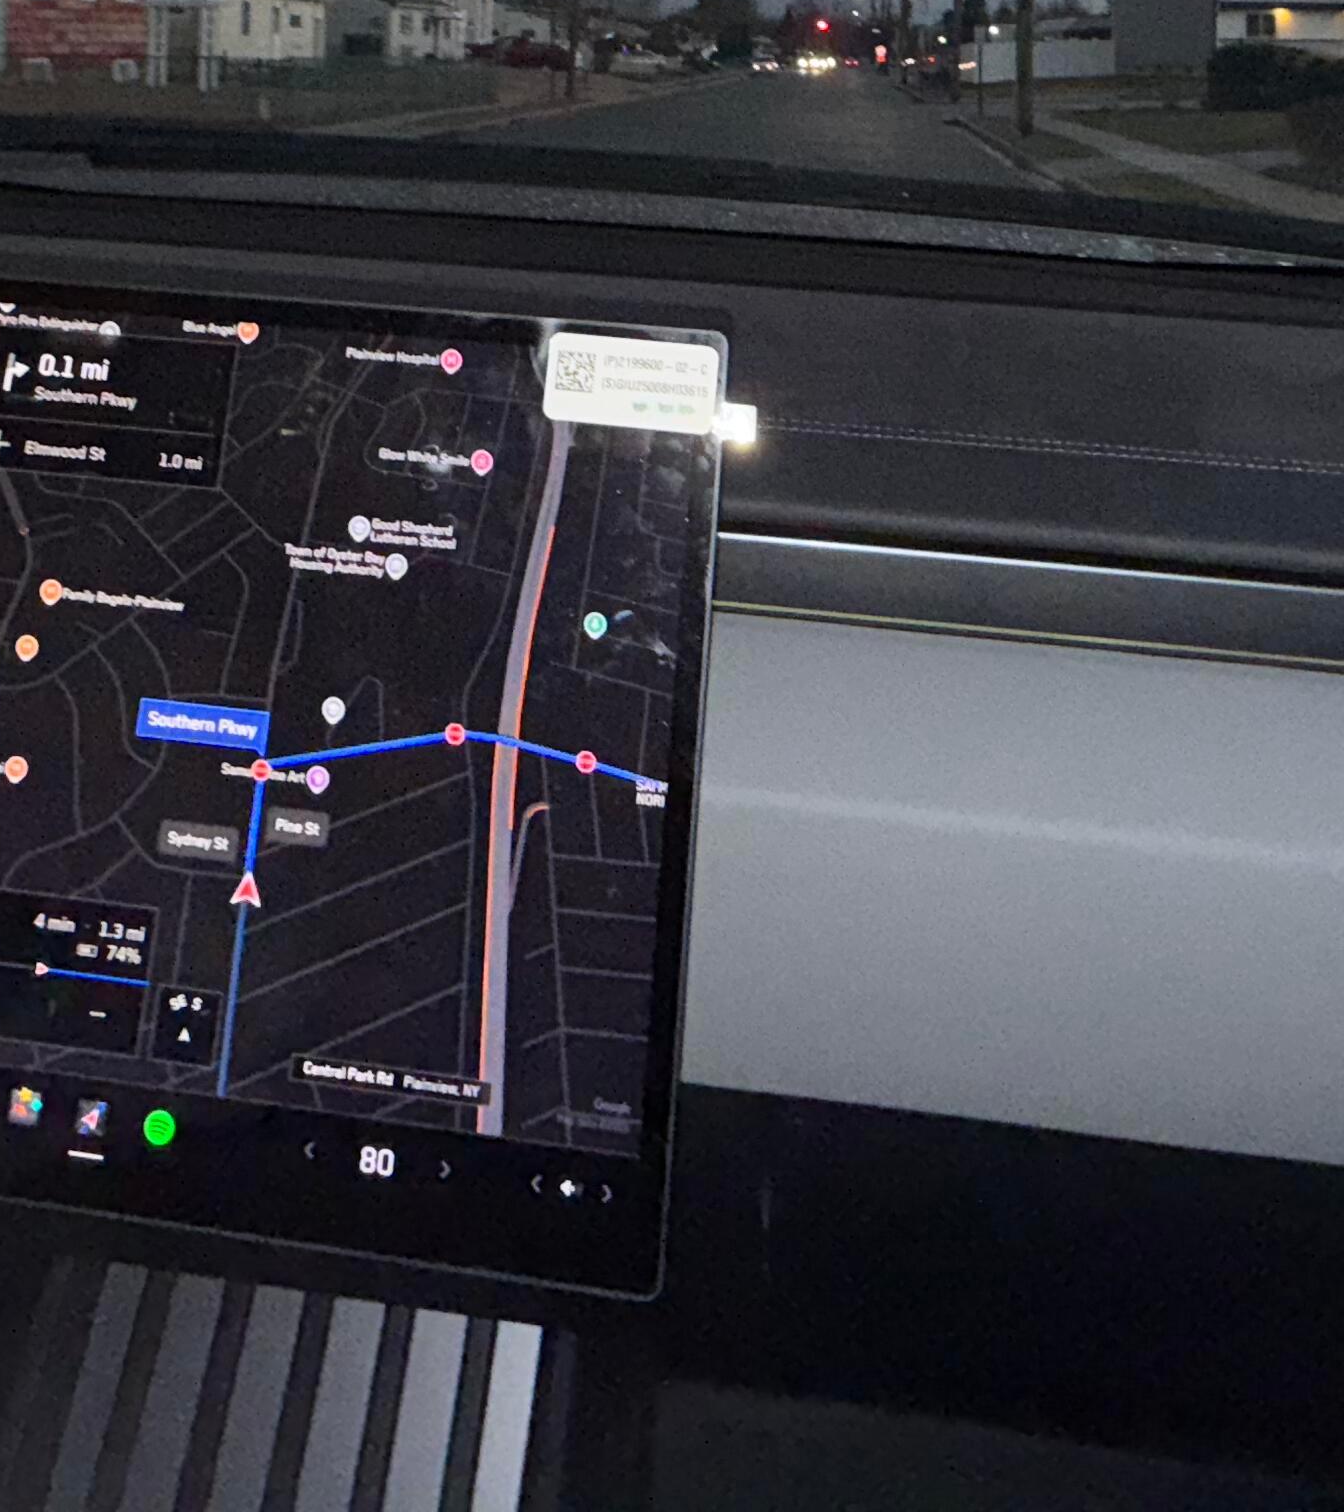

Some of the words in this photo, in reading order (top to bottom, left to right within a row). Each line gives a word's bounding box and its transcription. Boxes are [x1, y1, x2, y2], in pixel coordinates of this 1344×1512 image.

[38, 352, 74, 379] 0.1
[80, 357, 111, 381] mi
[34, 385, 98, 406] Southern
[99, 391, 138, 412] Pkwy
[23, 439, 88, 460] Elmwood
[88, 445, 106, 462] St
[158, 452, 183, 470] 1.0
[184, 455, 204, 471] mi
[313, 546, 327, 559] of
[419, 534, 457, 550] School
[147, 709, 216, 734] Southern
[218, 717, 259, 741] Pkwy
[275, 817, 303, 834] Pine
[304, 820, 321, 836] St
[167, 830, 212, 851] Sydney
[213, 835, 230, 852] St
[99, 920, 124, 940] 1.3
[125, 925, 146, 943] mi
[106, 943, 143, 966] 74%
[303, 1060, 346, 1080] Central
[347, 1065, 375, 1084] Park
[375, 1070, 395, 1087] Rd
[358, 1145, 396, 1178] 80
